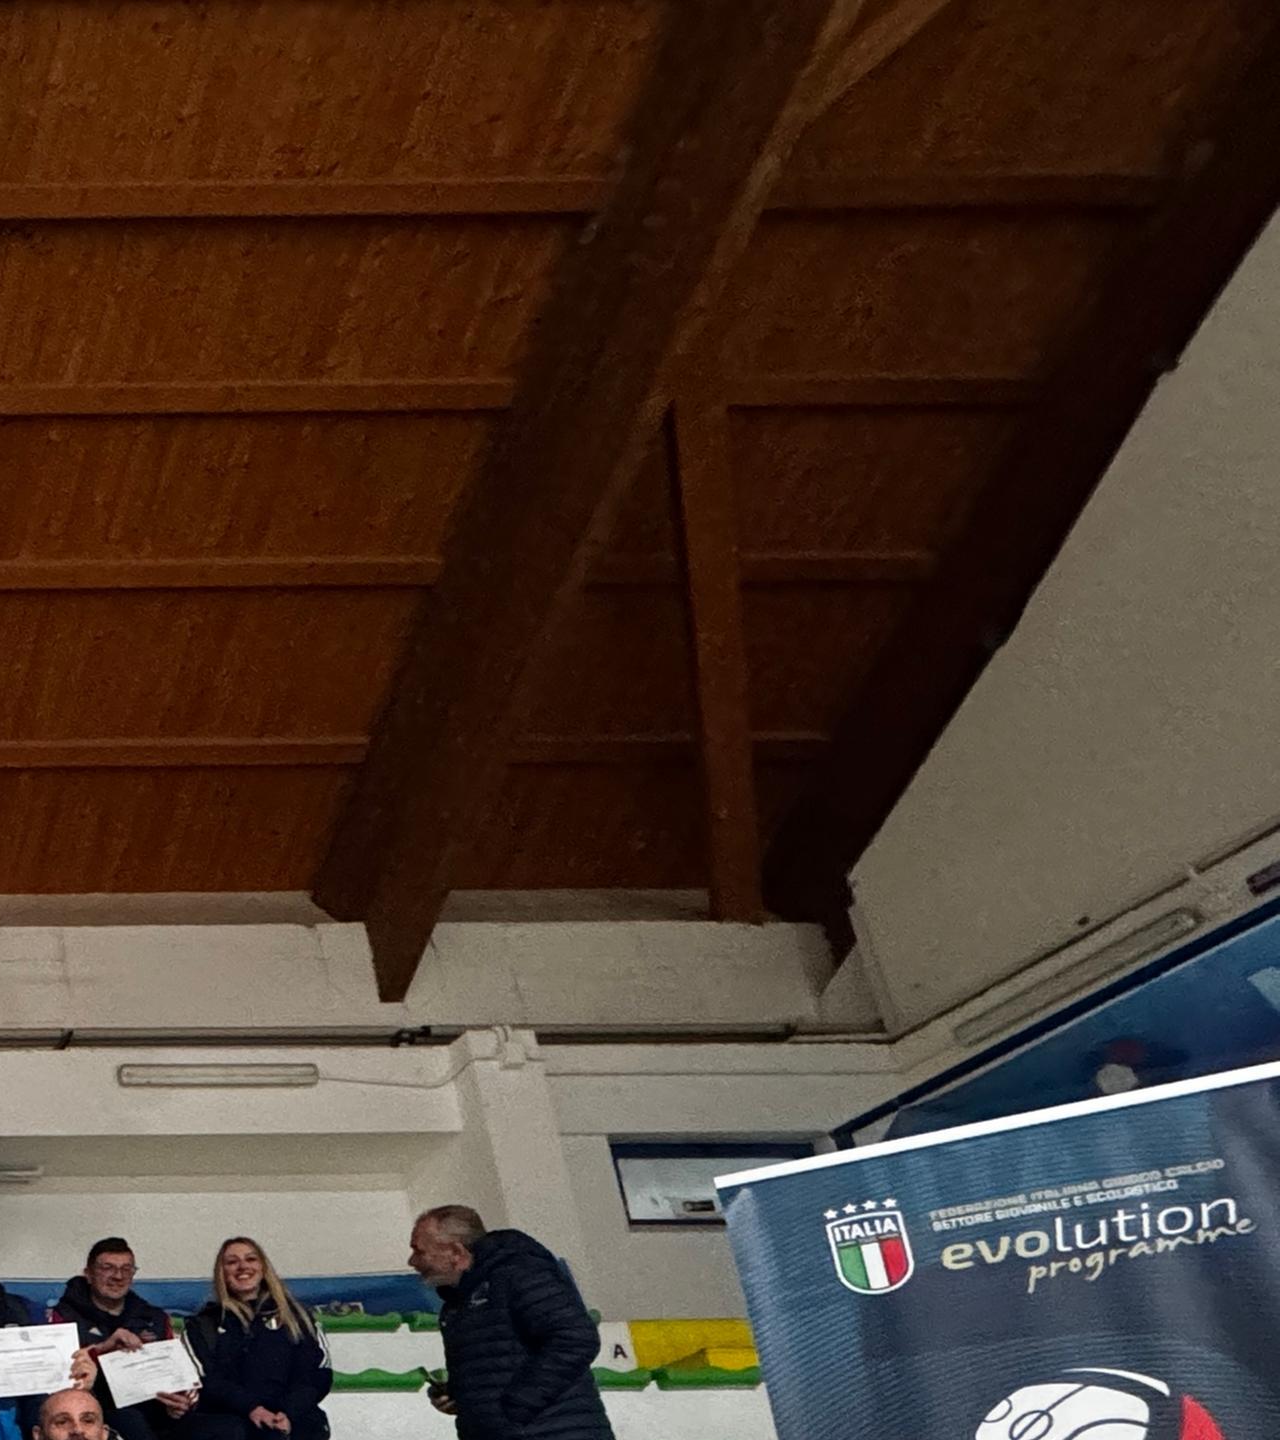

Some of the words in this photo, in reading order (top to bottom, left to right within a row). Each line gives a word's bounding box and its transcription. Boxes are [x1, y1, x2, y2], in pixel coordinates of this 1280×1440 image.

[834, 1217, 899, 1242] ITALIA
[942, 1197, 1238, 1270] evolution
[1028, 1215, 1257, 1293] programme
[613, 1344, 628, 1360] A
